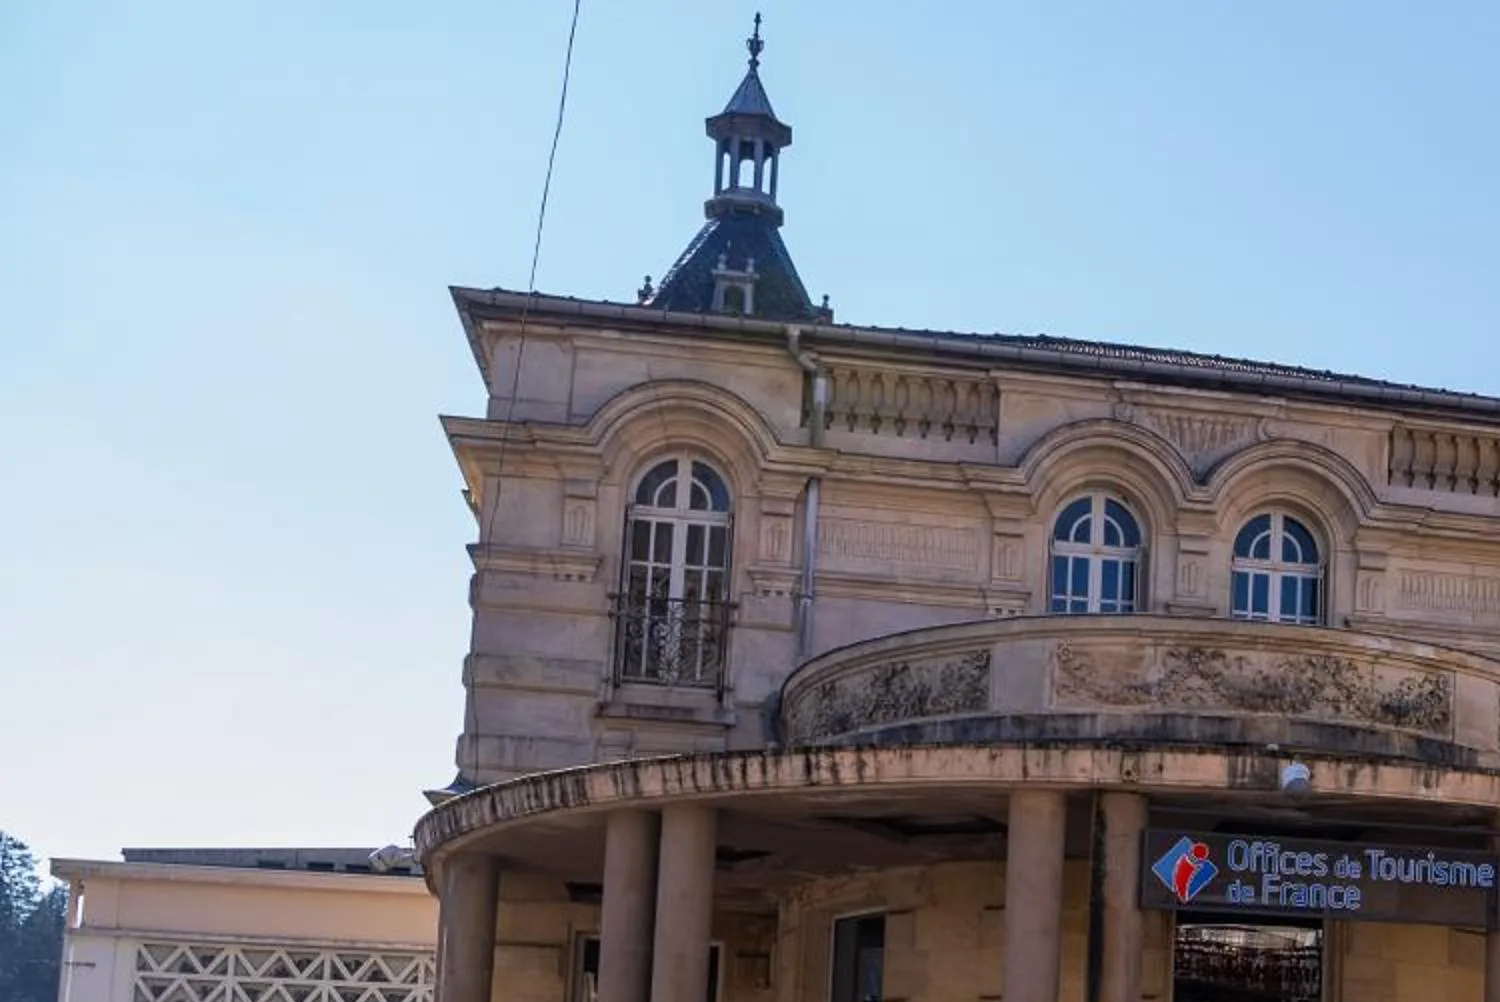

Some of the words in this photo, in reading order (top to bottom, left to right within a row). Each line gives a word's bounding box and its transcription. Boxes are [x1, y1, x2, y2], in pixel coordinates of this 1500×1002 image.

[1227, 839, 1329, 877] Offices
[1333, 854, 1362, 879] de
[1364, 849, 1495, 888] Tourisme
[1226, 879, 1255, 903] de
[1261, 873, 1361, 910] France
